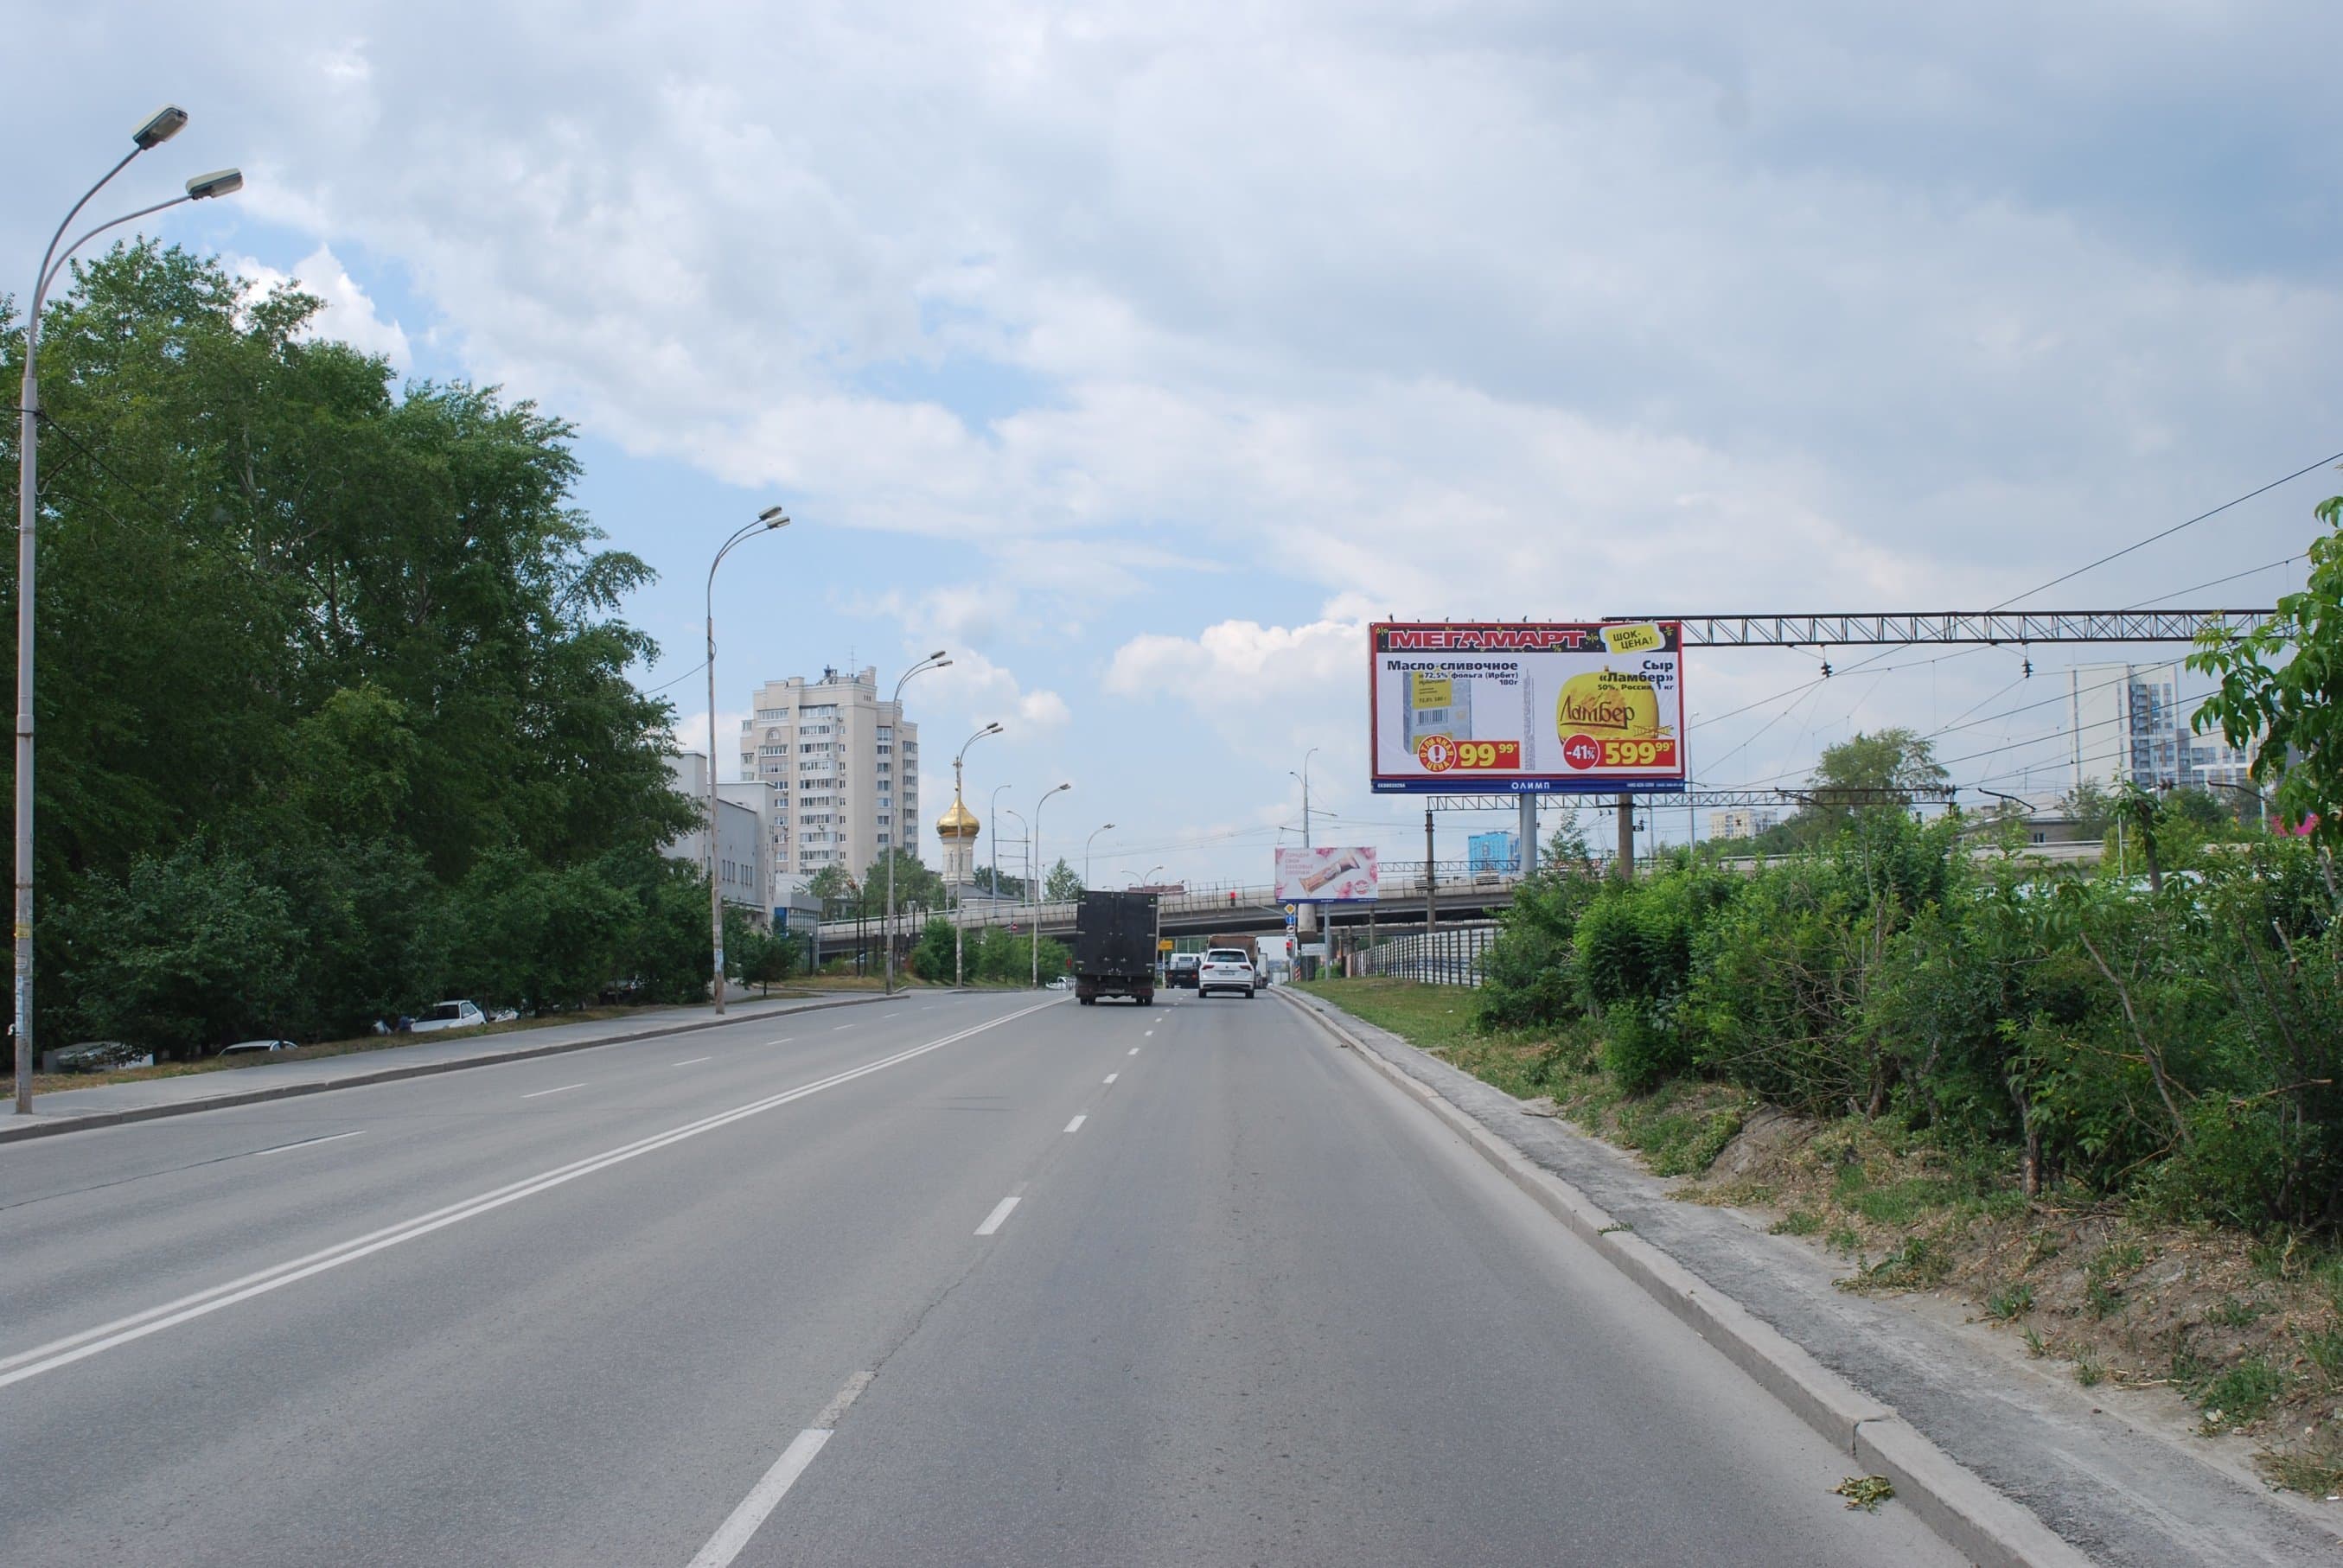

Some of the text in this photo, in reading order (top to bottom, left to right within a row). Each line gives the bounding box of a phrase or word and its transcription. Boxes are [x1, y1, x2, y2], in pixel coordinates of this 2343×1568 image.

[1389, 630, 1586, 648] МЕГАМАРТ
[1613, 629, 1641, 642] ШОК-
[1620, 636, 1653, 649] ЦЕНА!
[1387, 660, 1518, 671] Масло сливочное
[1642, 660, 1674, 672] Сыр
[1599, 672, 1674, 685] «Ламбер»
[1560, 695, 1635, 729] Ламбер
[1420, 736, 1454, 758] ОТЛИЧНАЯ
[1605, 742, 1657, 765] 599
[1426, 761, 1451, 771] ЦЕНА
[1511, 781, 1550, 790] ОЛИМП
